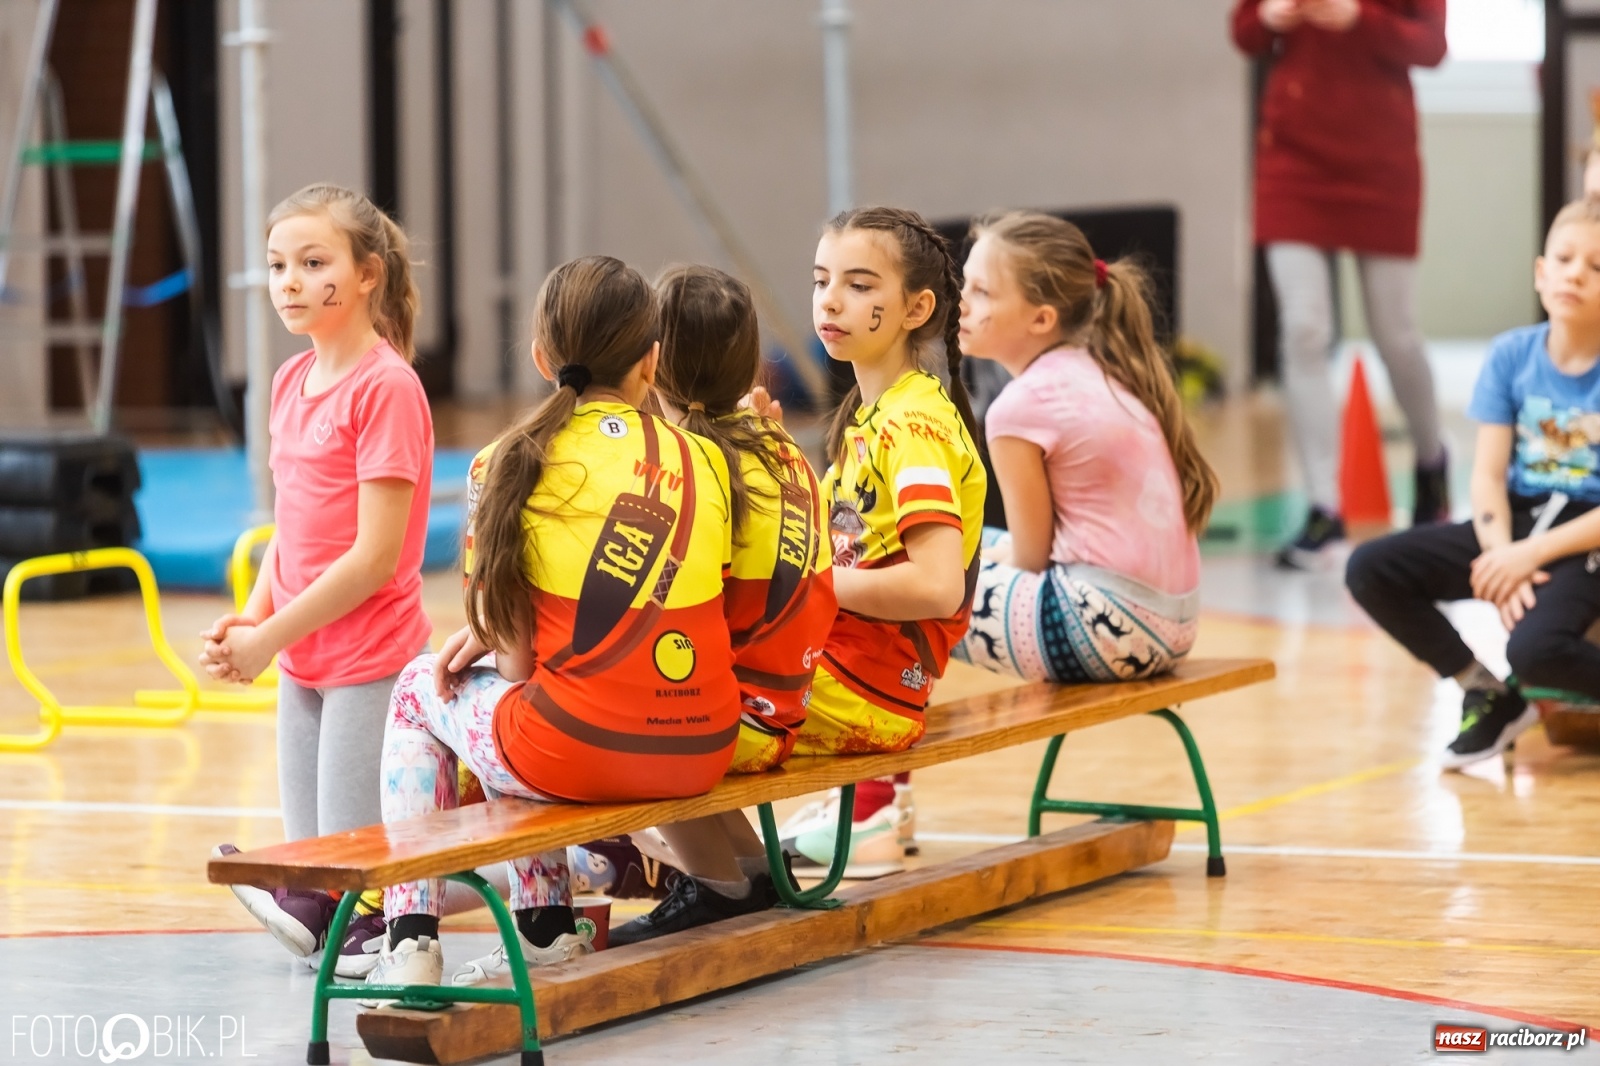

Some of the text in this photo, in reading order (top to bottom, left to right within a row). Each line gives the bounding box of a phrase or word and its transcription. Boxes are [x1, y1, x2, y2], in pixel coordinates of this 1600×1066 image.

[868, 305, 885, 332] 5
[607, 422, 620, 434] B
[779, 499, 807, 571] EMI
[596, 521, 654, 588] IGA
[646, 715, 711, 725] Media Walk
